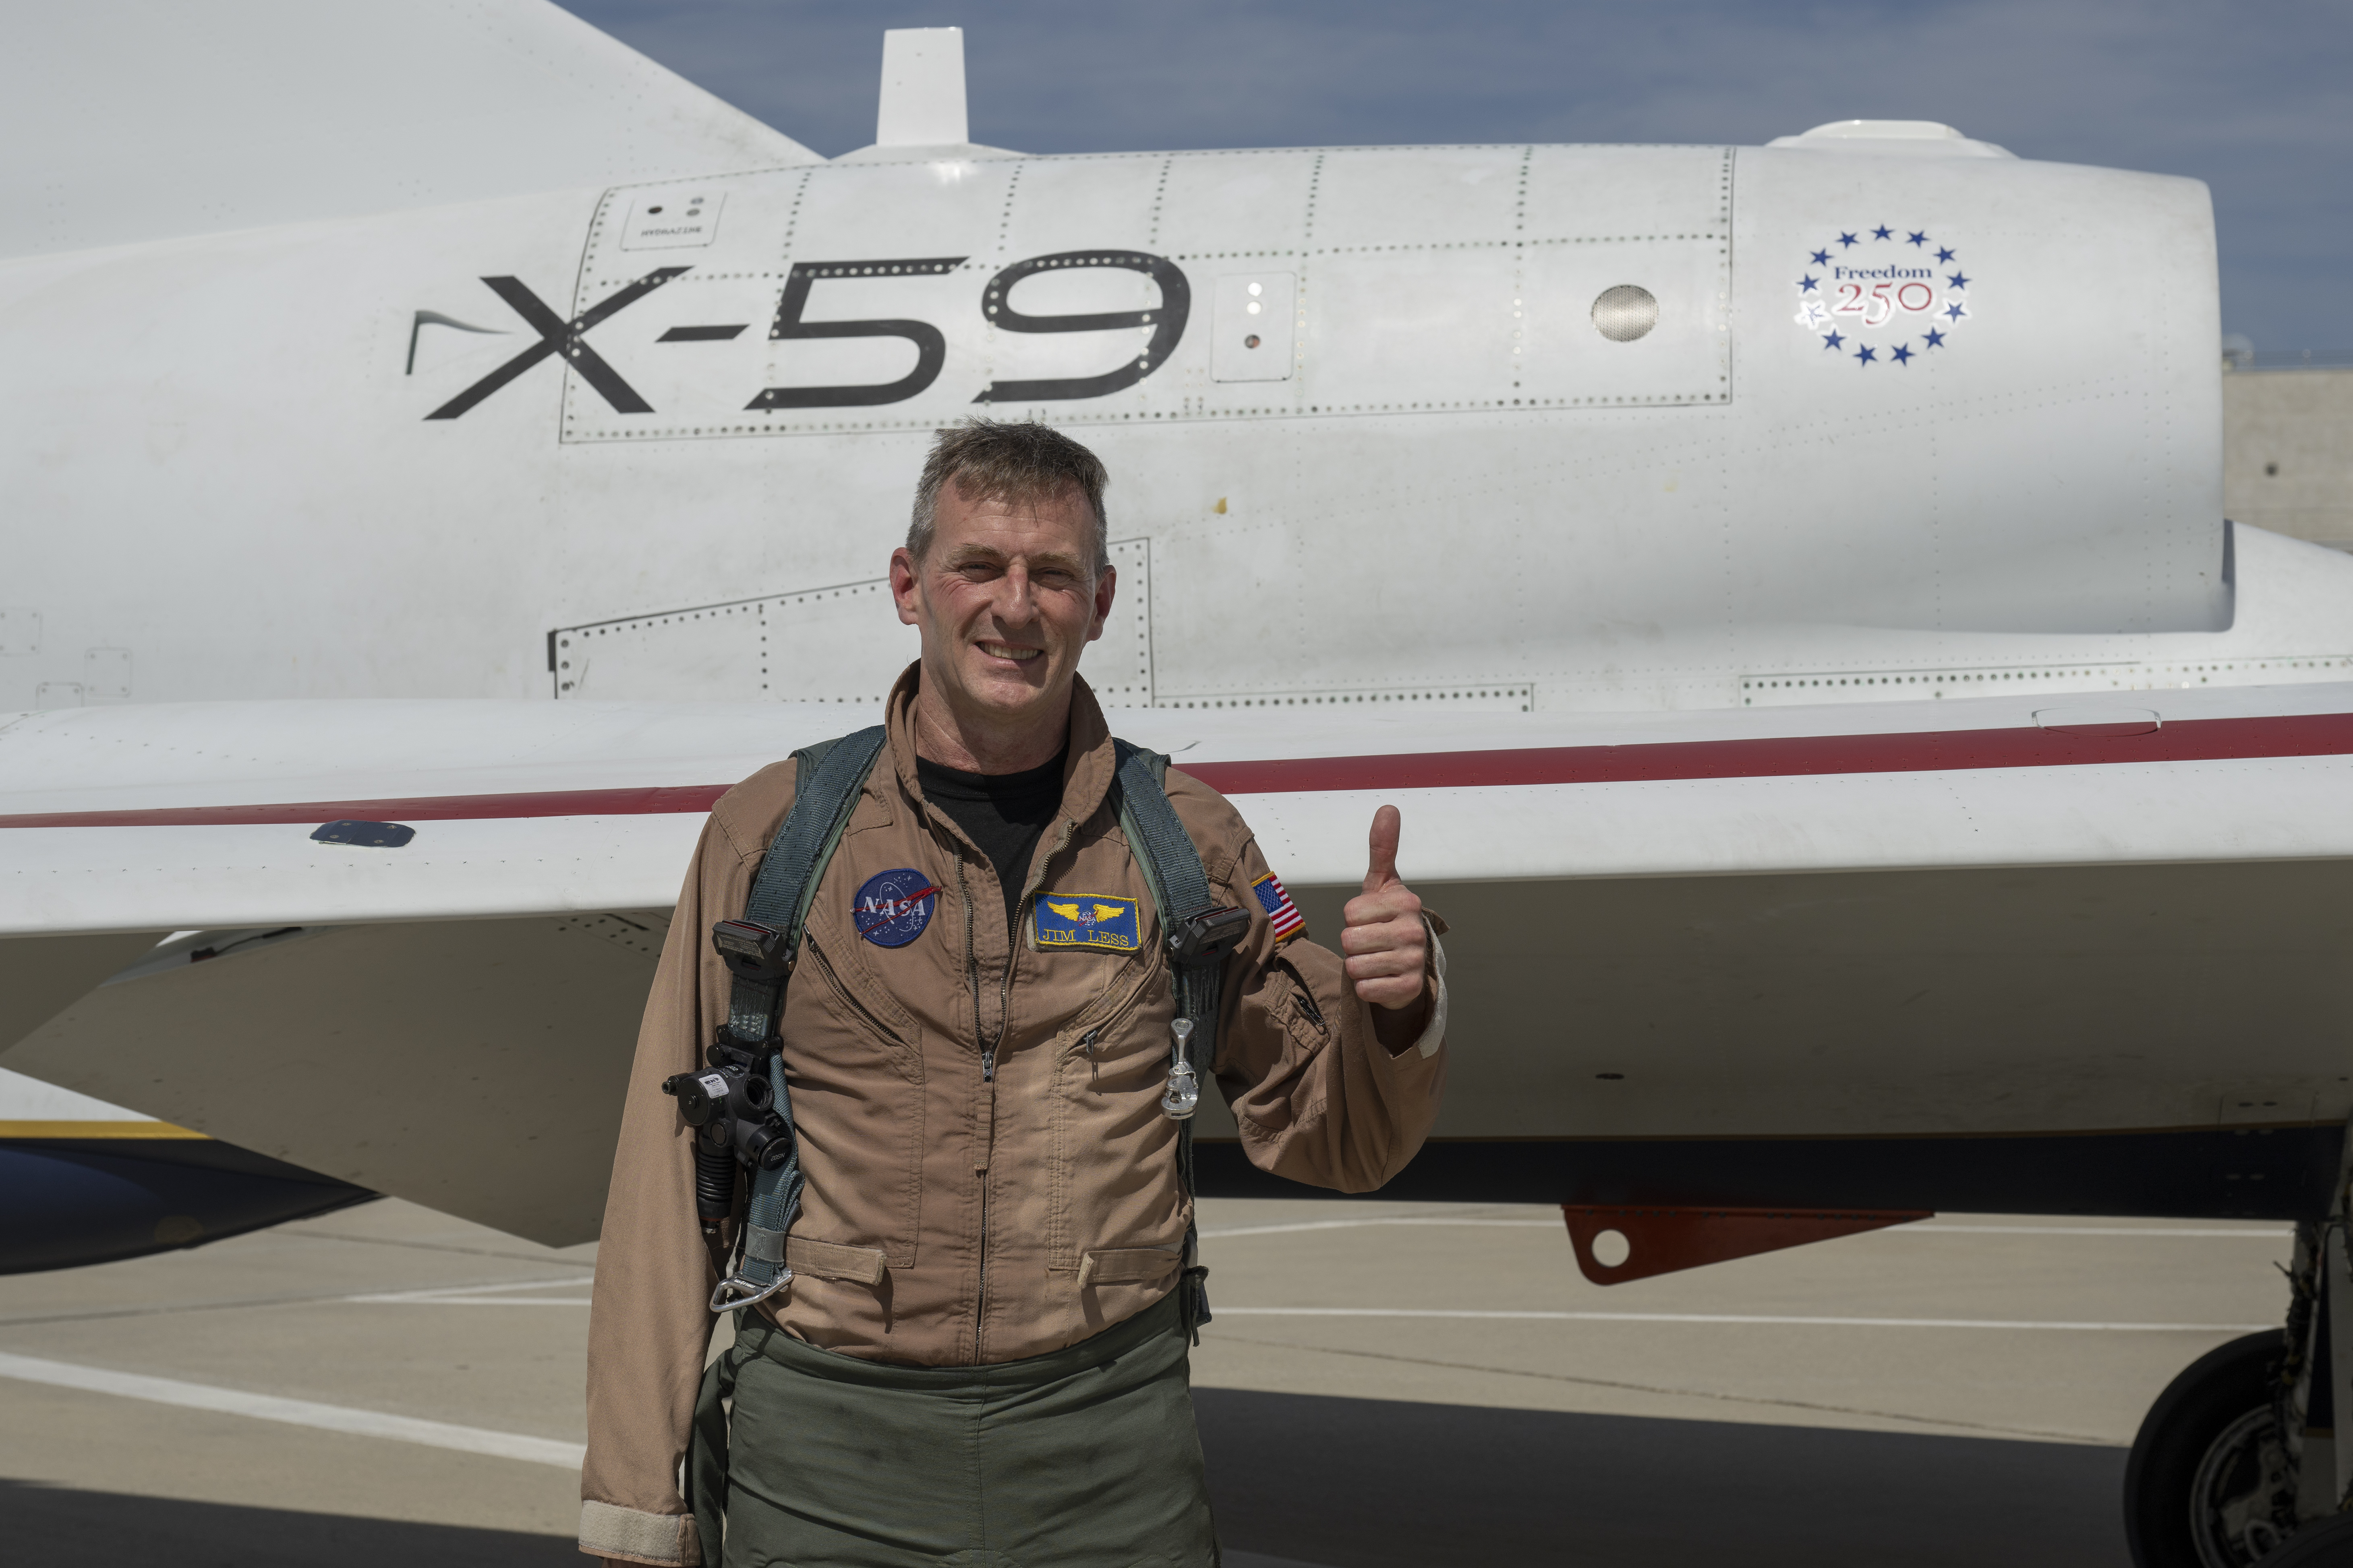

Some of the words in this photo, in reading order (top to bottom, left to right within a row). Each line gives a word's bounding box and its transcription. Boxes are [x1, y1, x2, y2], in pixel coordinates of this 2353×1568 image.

[1834, 265, 1933, 279] Freedom
[1836, 281, 1932, 325] 250
[422, 249, 1191, 420] X-59
[862, 896, 926, 916] NASA
[1042, 929, 1077, 941] JIM
[1087, 930, 1129, 946] LESS
